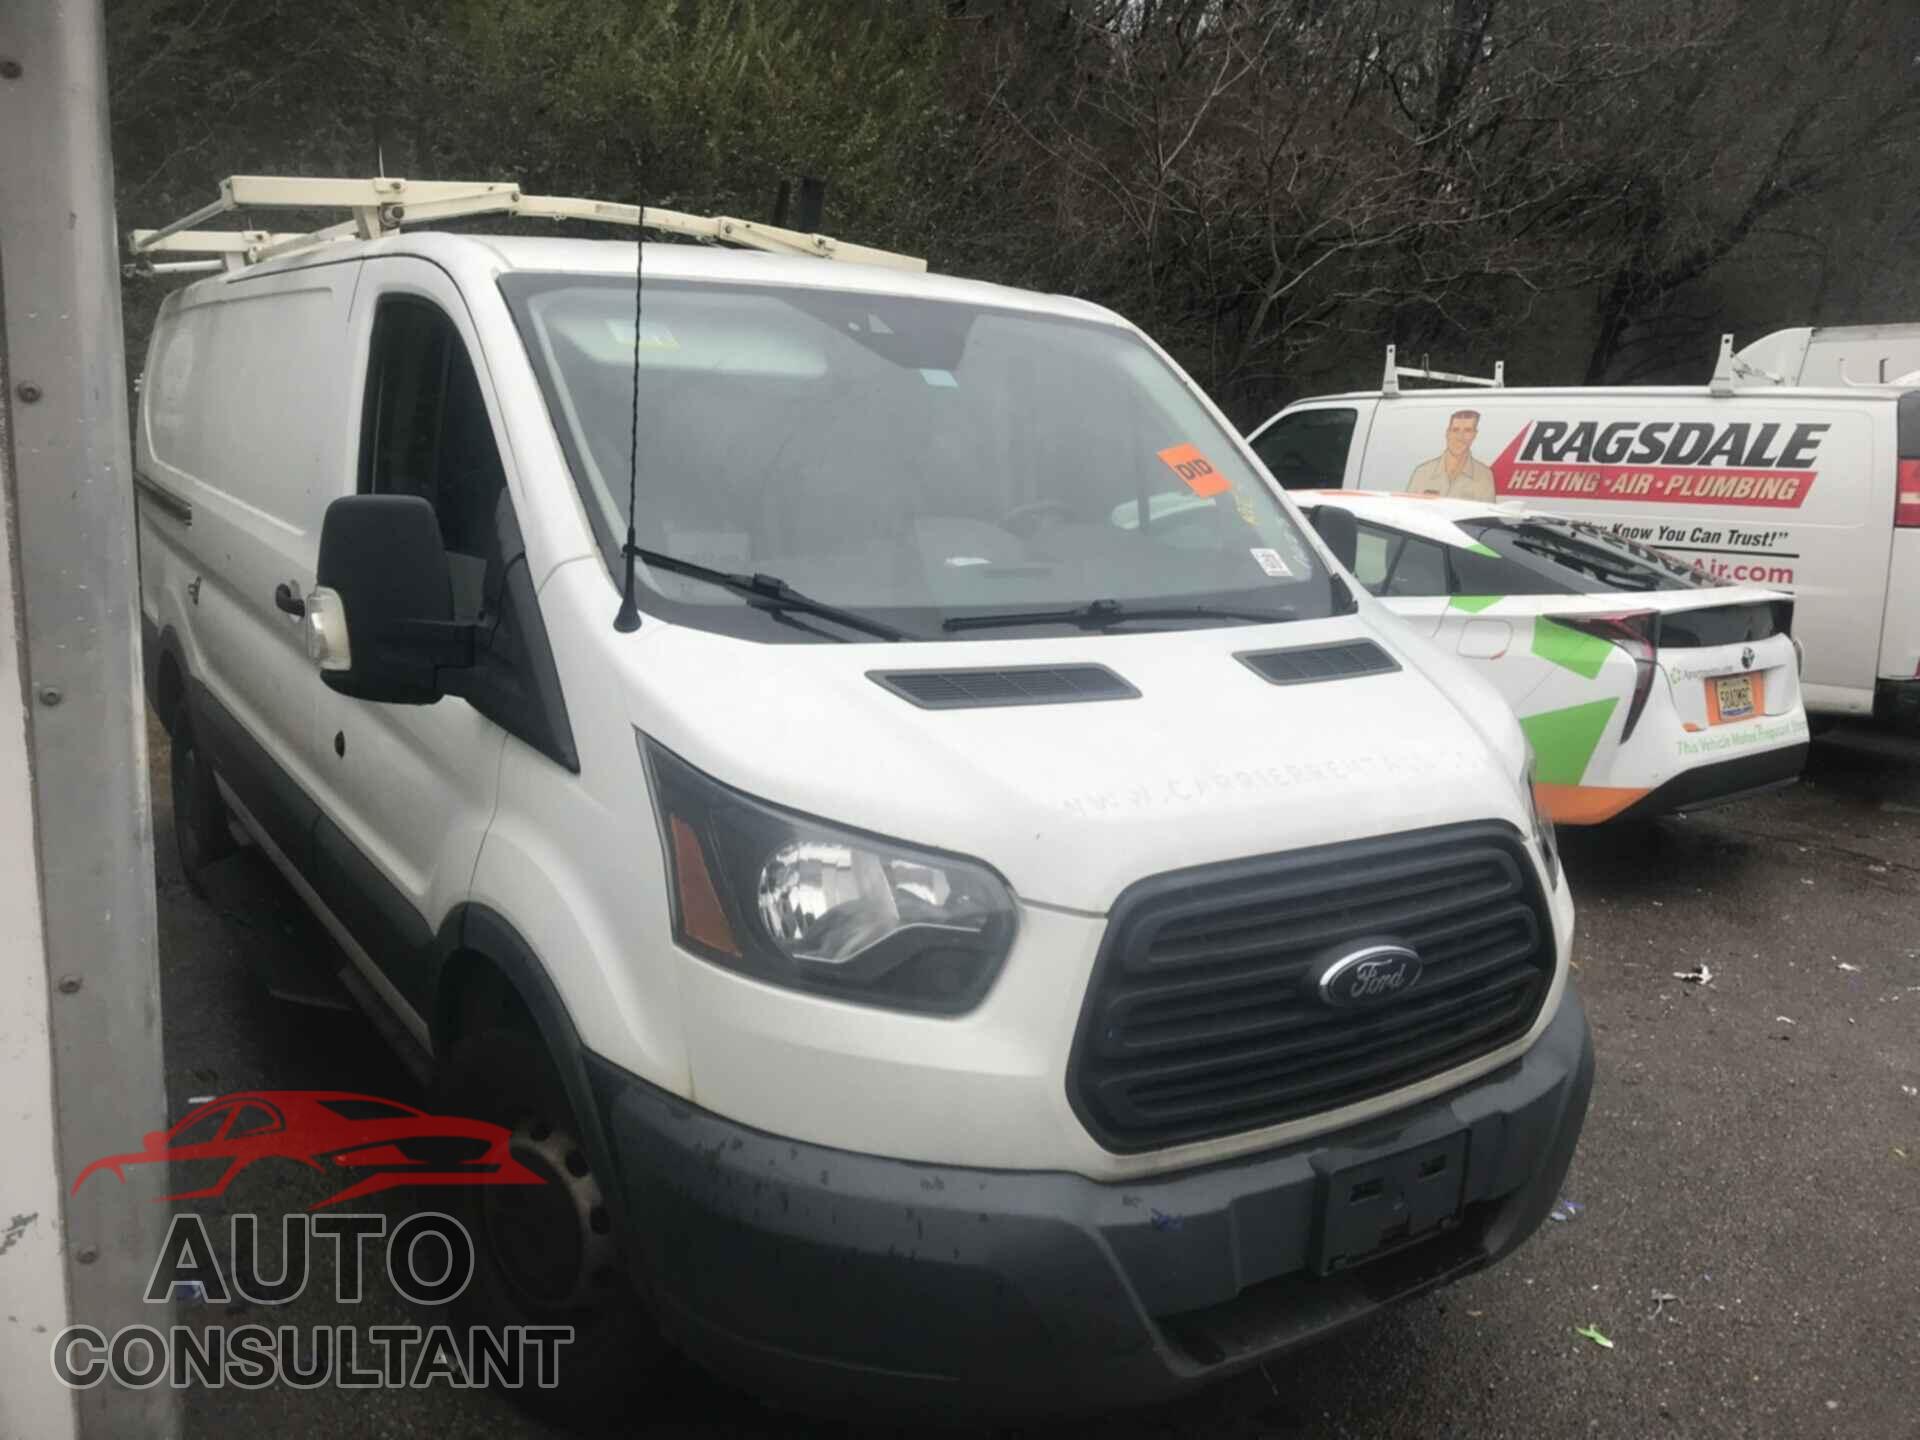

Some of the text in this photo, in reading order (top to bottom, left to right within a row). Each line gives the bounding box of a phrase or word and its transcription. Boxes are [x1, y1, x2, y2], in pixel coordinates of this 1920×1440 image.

[1519, 420, 1831, 468] RAGSDALE
[1507, 469, 1801, 500] HEATING AIR PLUMBING
[1612, 522, 1653, 540] Know
[1658, 525, 1686, 542] You
[1690, 527, 1722, 544] Can
[1351, 958, 1406, 997] Ford
